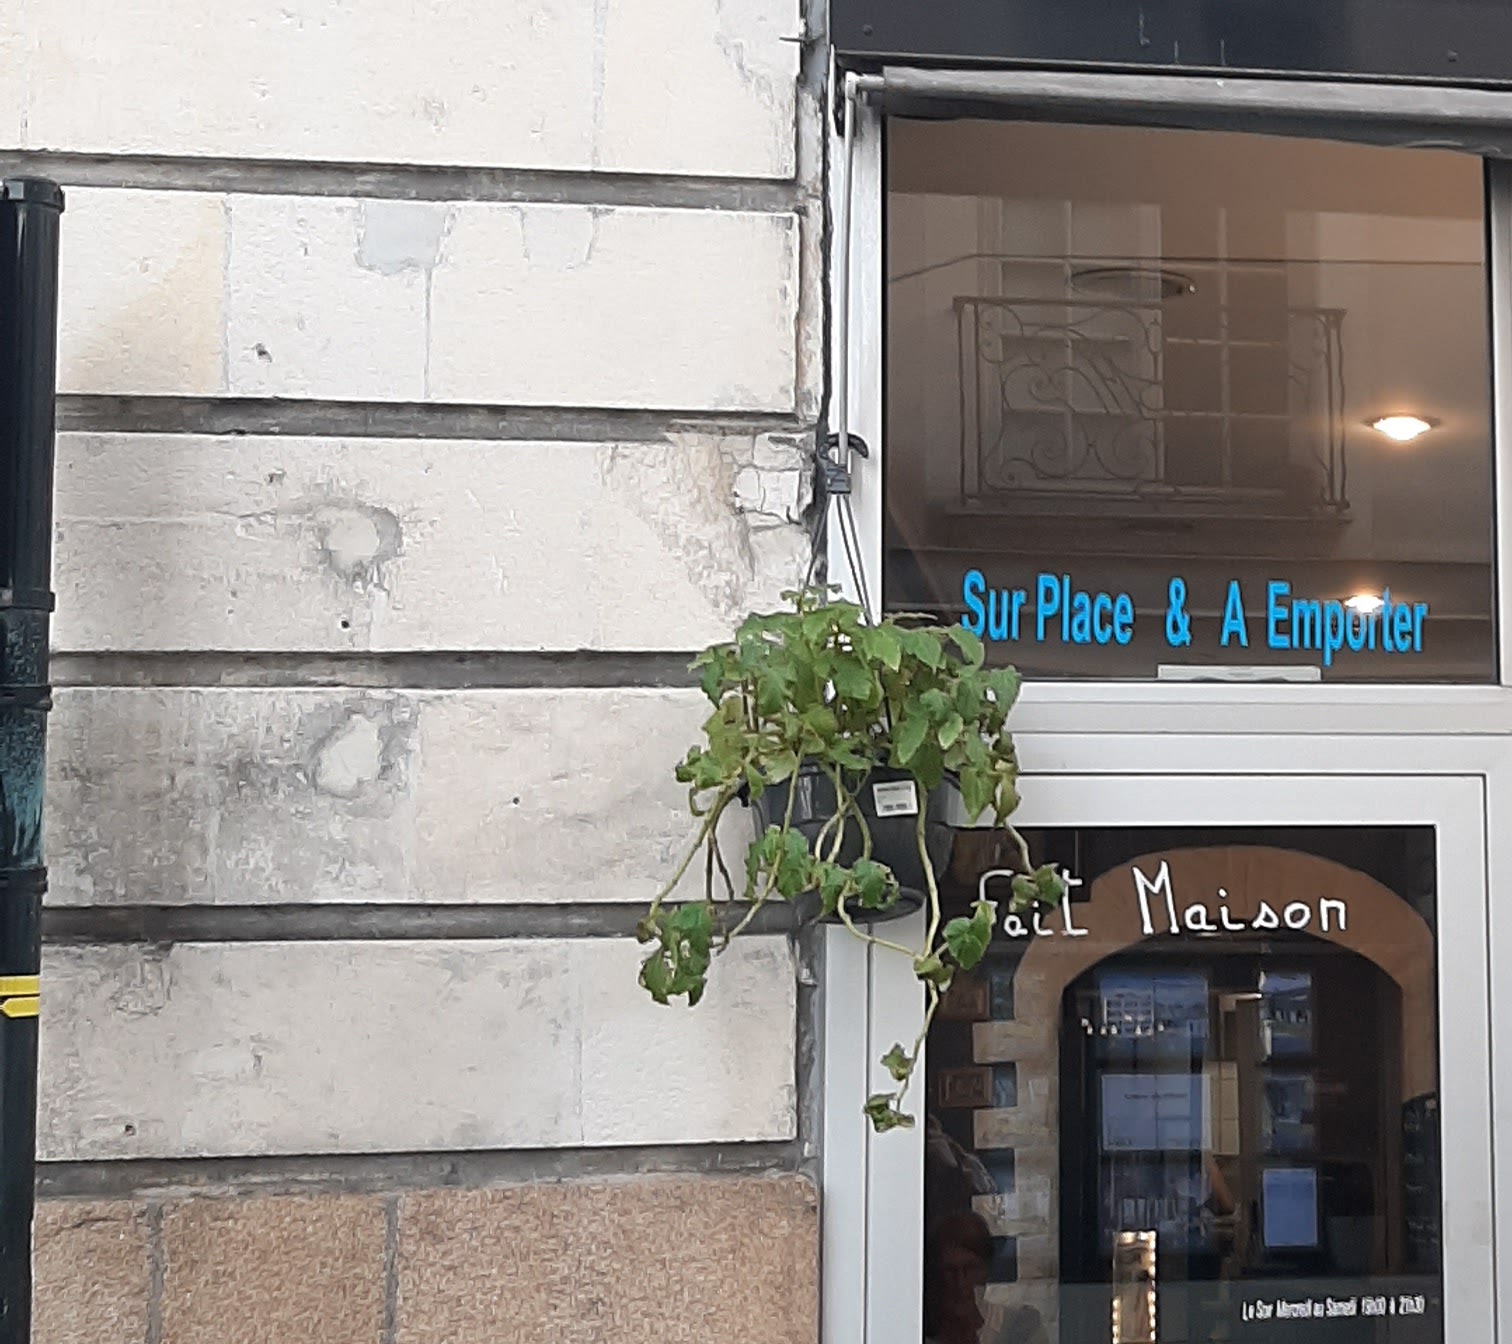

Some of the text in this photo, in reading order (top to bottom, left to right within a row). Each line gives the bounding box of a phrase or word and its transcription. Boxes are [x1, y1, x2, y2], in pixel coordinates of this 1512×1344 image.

[961, 569, 1429, 666] Sur Place & A Emporter
[1131, 859, 1347, 936] Maison
